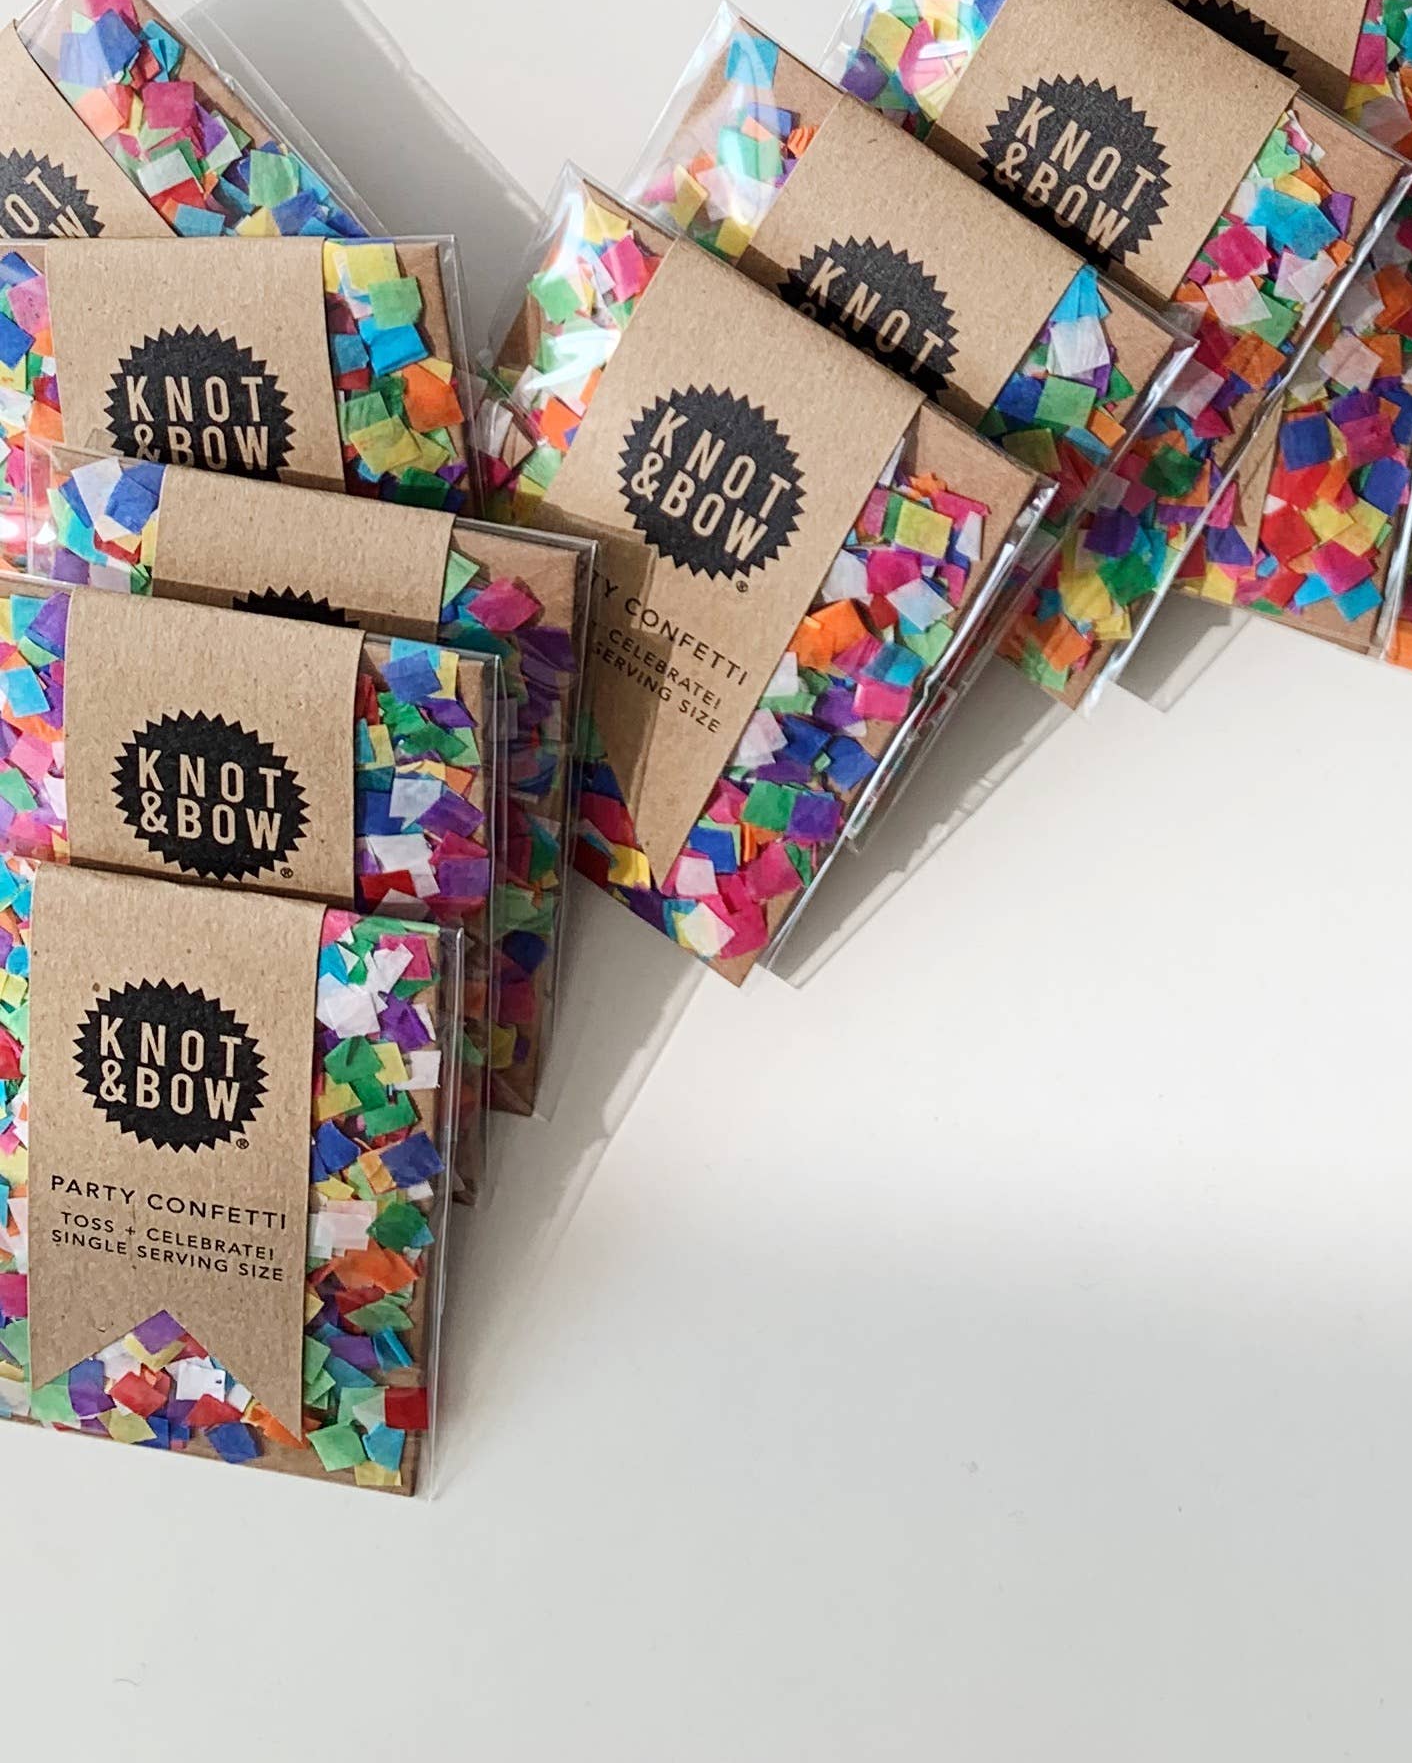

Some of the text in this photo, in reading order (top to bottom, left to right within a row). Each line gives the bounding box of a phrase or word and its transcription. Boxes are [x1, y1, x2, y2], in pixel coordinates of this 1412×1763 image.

[1015, 97, 1157, 211] KNOT
[0, 168, 62, 237] OT
[994, 142, 1131, 253] &BOW
[806, 256, 945, 374] KNOT
[126, 375, 264, 423] KNOT
[133, 424, 270, 471] &BOW
[650, 407, 792, 519] KNOT
[631, 451, 768, 561] &BOW
[609, 629, 722, 710] CELEBRATE!
[624, 597, 748, 685] CONFETTI
[679, 699, 721, 733] SIZE
[138, 747, 281, 808] KNOT
[140, 791, 281, 852] &BOW
[100, 1014, 242, 1078] KNOT
[99, 1059, 241, 1122] &BOW
[51, 1174, 287, 1230] PARTY CONFETTI
[51, 1229, 285, 1282] SINGLE SERVING SIZE
[61, 1212, 275, 1261] TOSS + CELEBRATE!
